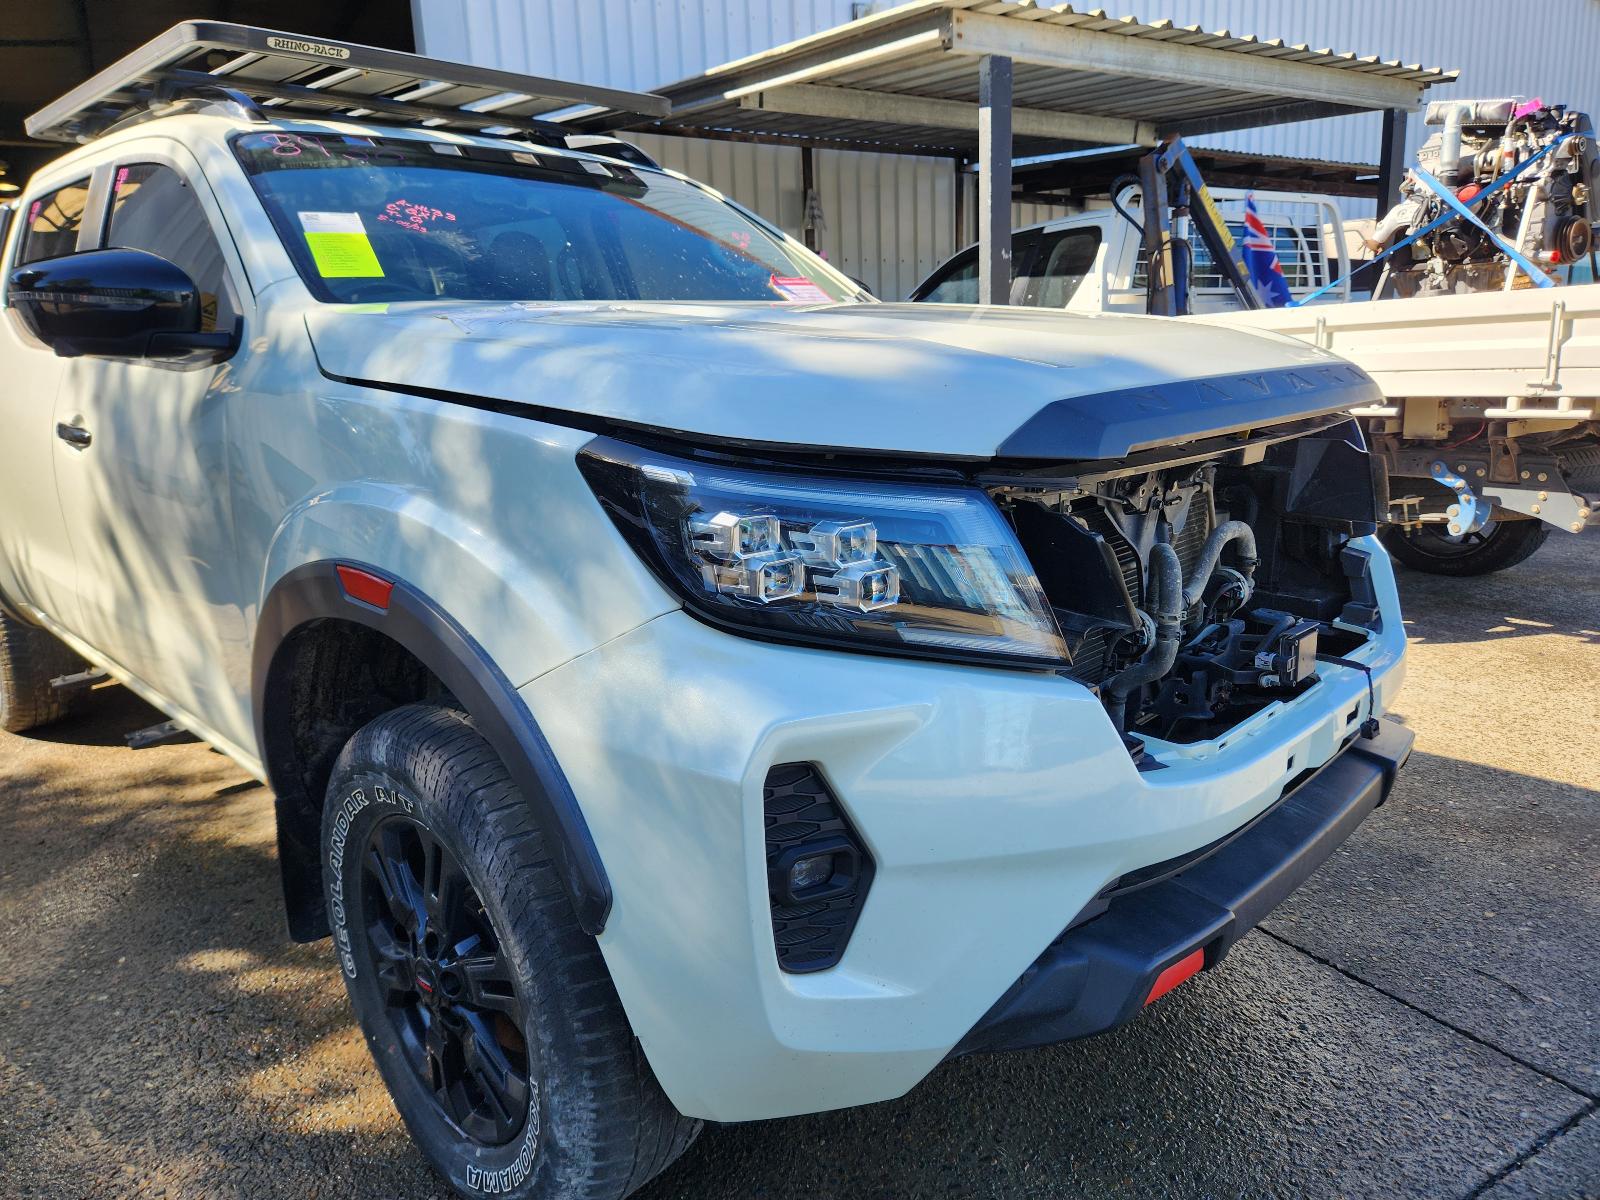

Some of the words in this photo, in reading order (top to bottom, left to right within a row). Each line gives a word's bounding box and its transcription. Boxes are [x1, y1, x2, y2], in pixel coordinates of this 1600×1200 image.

[273, 38, 344, 58] RHINO-RACK
[329, 788, 370, 979] GEOLANDAR
[466, 1076, 541, 1194] YOKOHAMA
